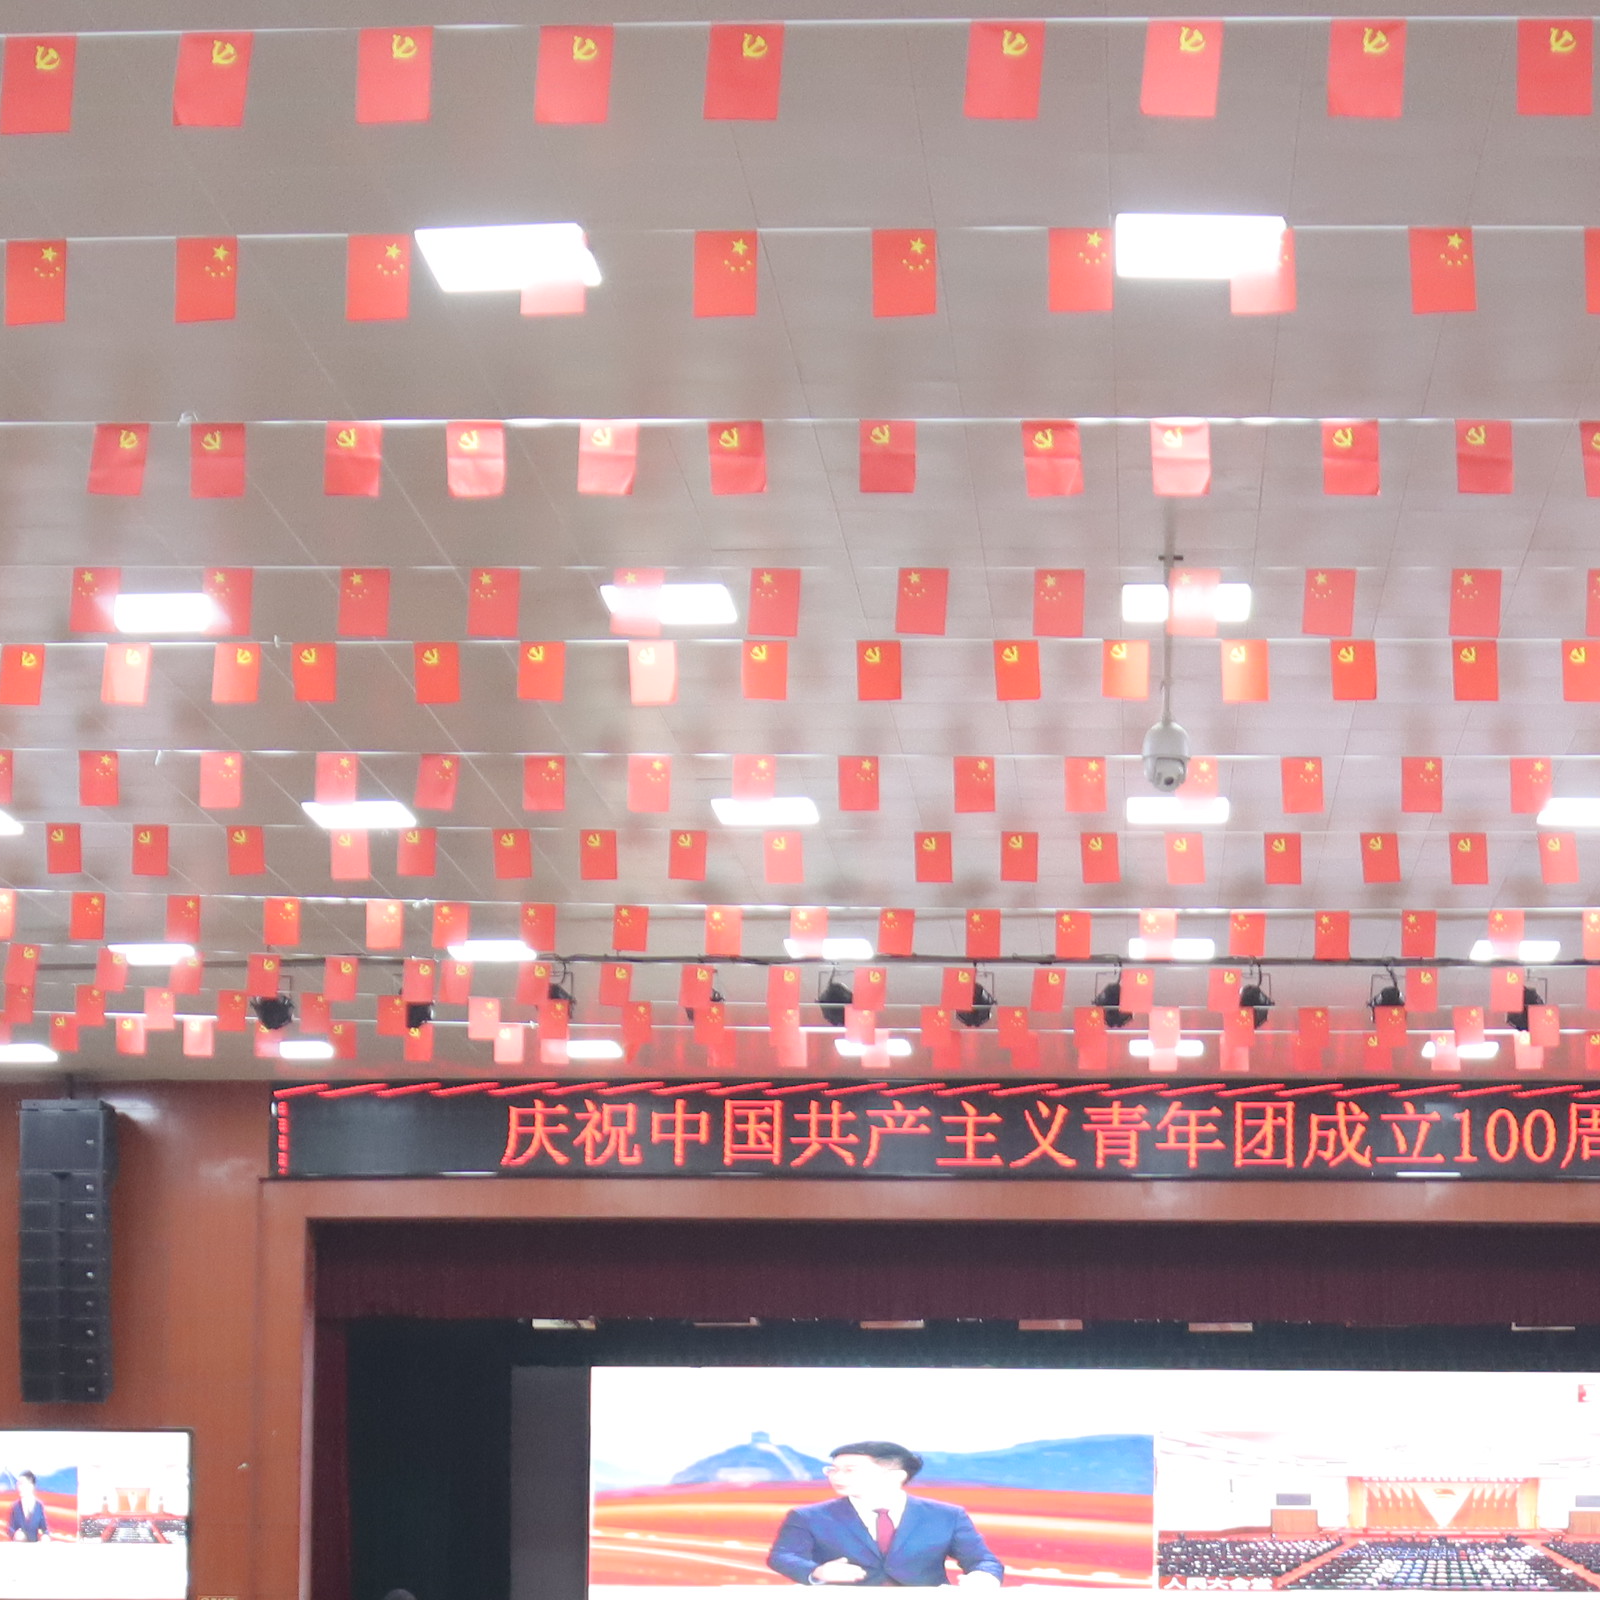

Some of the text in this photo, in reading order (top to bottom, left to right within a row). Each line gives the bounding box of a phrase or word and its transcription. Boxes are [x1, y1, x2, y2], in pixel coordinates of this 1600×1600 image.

[1164, 1577, 1273, 1590] 人民大会堂
